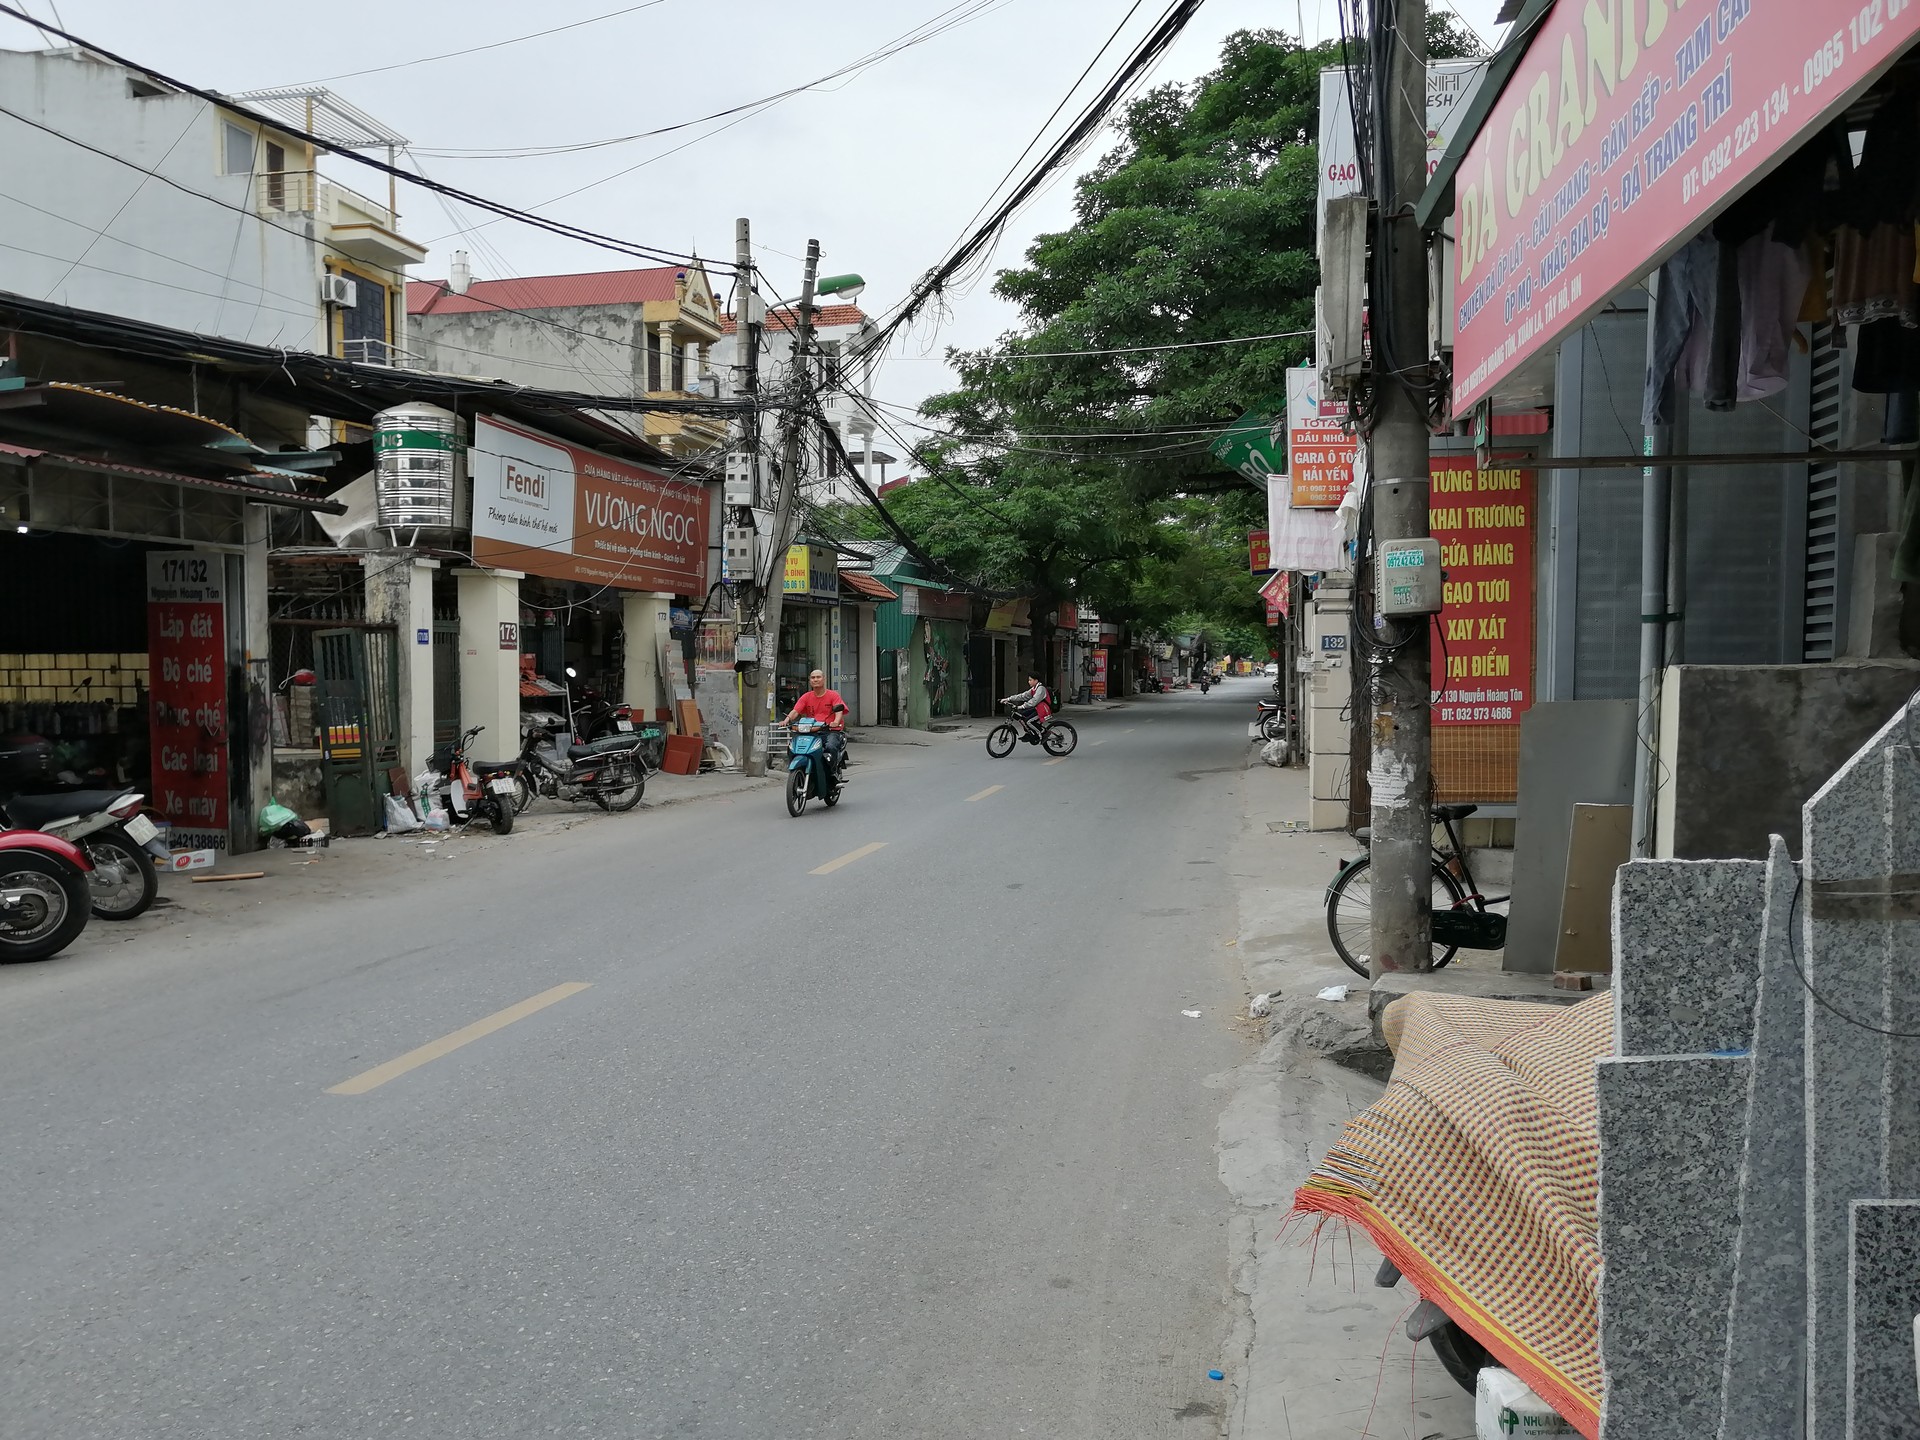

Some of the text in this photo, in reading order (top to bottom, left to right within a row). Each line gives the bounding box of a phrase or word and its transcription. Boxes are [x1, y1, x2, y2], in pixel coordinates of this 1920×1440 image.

[1702, 137, 1732, 187] 0392
[1735, 110, 1759, 158] 223
[1763, 82, 1789, 132] 134
[1803, 30, 1844, 95] 0965
[1849, 0, 1884, 53] 102
[1553, 159, 1590, 227] THANG
[1600, 112, 1629, 176] BÀN
[1632, 71, 1661, 143] BẾP
[1675, 13, 1712, 93] TAM
[1460, 0, 1690, 285] ĐÁ GRANI
[1328, 164, 1356, 185] GẠO
[1539, 232, 1568, 292] KHẮC
[1569, 214, 1590, 264] BIA
[1592, 187, 1609, 239] BỘ
[1621, 153, 1641, 213] ĐÁ
[1644, 101, 1698, 189] TRANG
[1701, 52, 1733, 132] TRÍ
[1297, 431, 1318, 443] DẦU
[1295, 450, 1354, 464] GARA Ô TÔ
[506, 465, 545, 499] Fendi
[1303, 466, 1348, 481] HẢI YẾN
[585, 490, 695, 550] VƯƠNG NGỌC
[1429, 504, 1525, 530] KHAI TRƯƠNG
[1440, 538, 1514, 567] CỬA HÀNG
[162, 559, 207, 583] 171/32
[1443, 579, 1510, 608] GẠO TƯƠI
[160, 608, 213, 645] Lắp đặt
[658, 612, 667, 620] 173
[1447, 613, 1507, 640] XAY XÁT
[500, 623, 517, 641] 173
[1323, 637, 1345, 649] 132
[163, 654, 212, 690] Độ chế
[1447, 646, 1510, 682] TẠI ĐIỂM
[1444, 690, 1457, 703] 130
[1459, 687, 1485, 704] Nguyễn
[1486, 689, 1508, 704] Hoàng
[1510, 688, 1522, 702] Tôn
[196, 699, 222, 728] chế
[1456, 707, 1471, 720] 032
[1473, 707, 1489, 720] 973
[1491, 707, 1512, 720] 4686
[161, 745, 187, 771] Các
[165, 790, 218, 823] Xe máy
